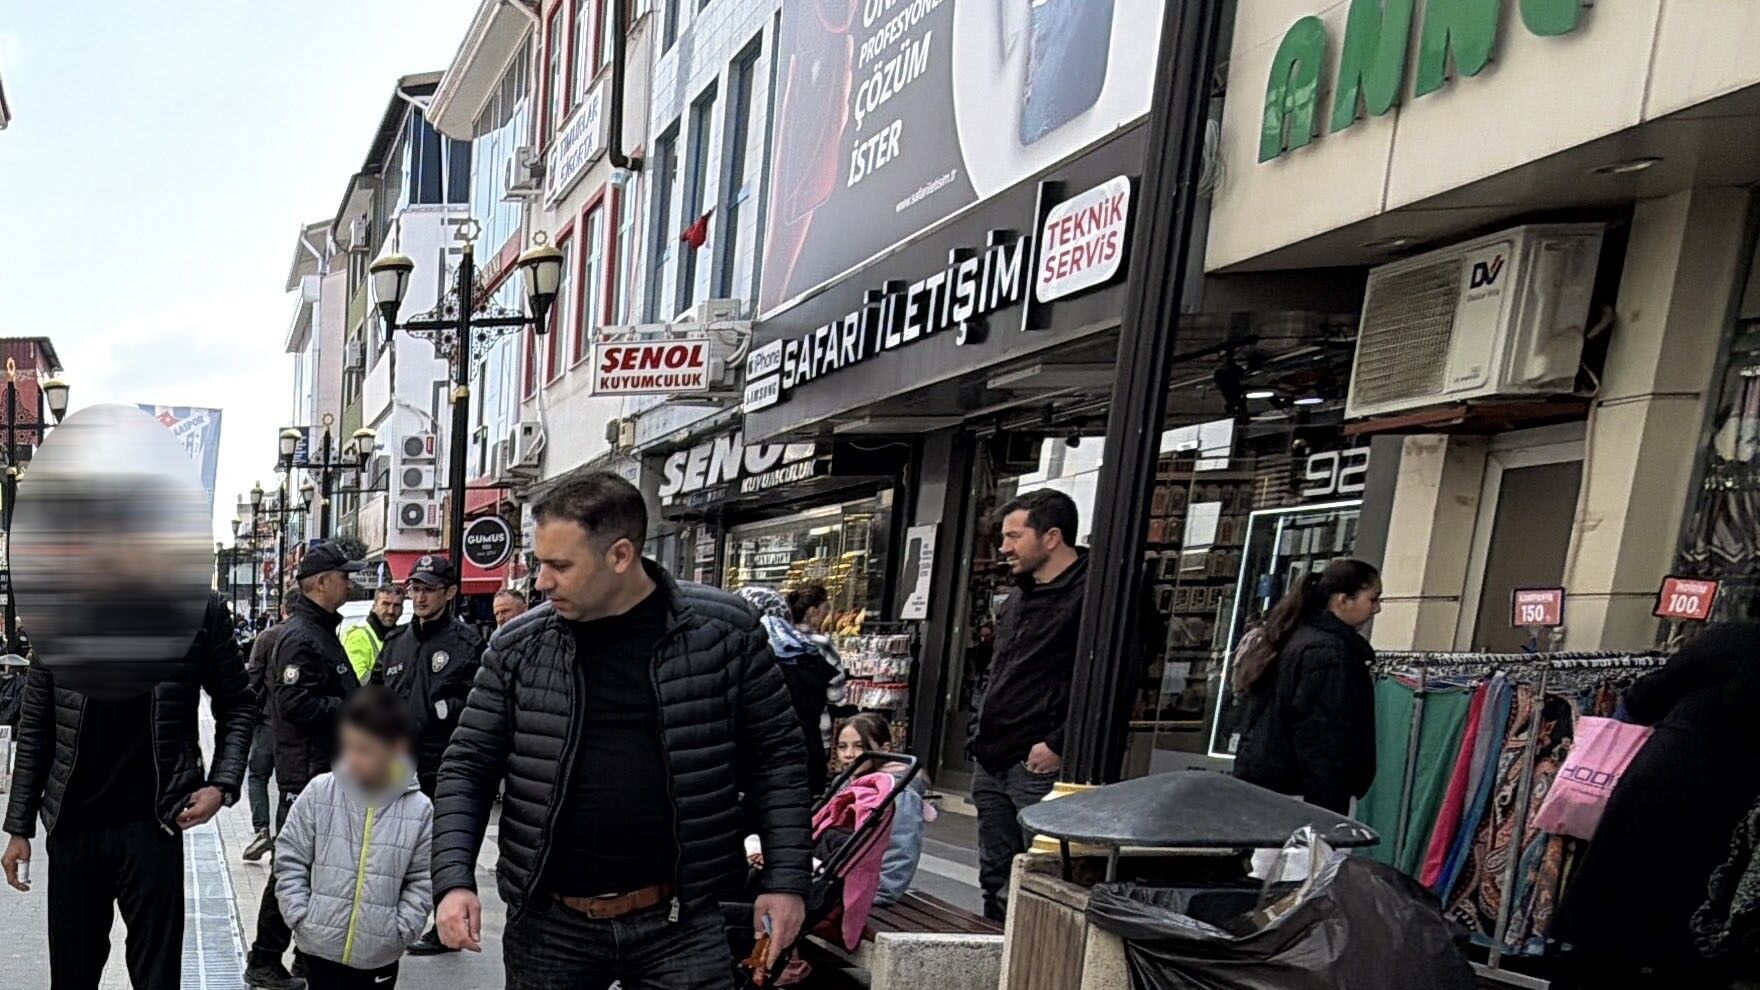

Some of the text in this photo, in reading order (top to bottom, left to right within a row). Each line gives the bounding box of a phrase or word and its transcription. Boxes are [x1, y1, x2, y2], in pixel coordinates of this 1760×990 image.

[855, 30, 932, 131] ÇÖZÜM
[1258, 0, 1579, 163] ANN
[847, 119, 903, 187] İSTER
[1047, 191, 1124, 250] TEKNİK
[1042, 231, 1119, 284] SERVİS
[874, 230, 1025, 352] İLETİŞİM
[600, 373, 703, 389] KUYUMCULUK
[601, 345, 704, 373] ŞENOL
[746, 383, 777, 406] SAMSUNG
[741, 459, 816, 494] KUYUMCULUK
[1303, 446, 1370, 497] 92
[1521, 604, 1545, 622] 150
[1668, 594, 1699, 613] 100
